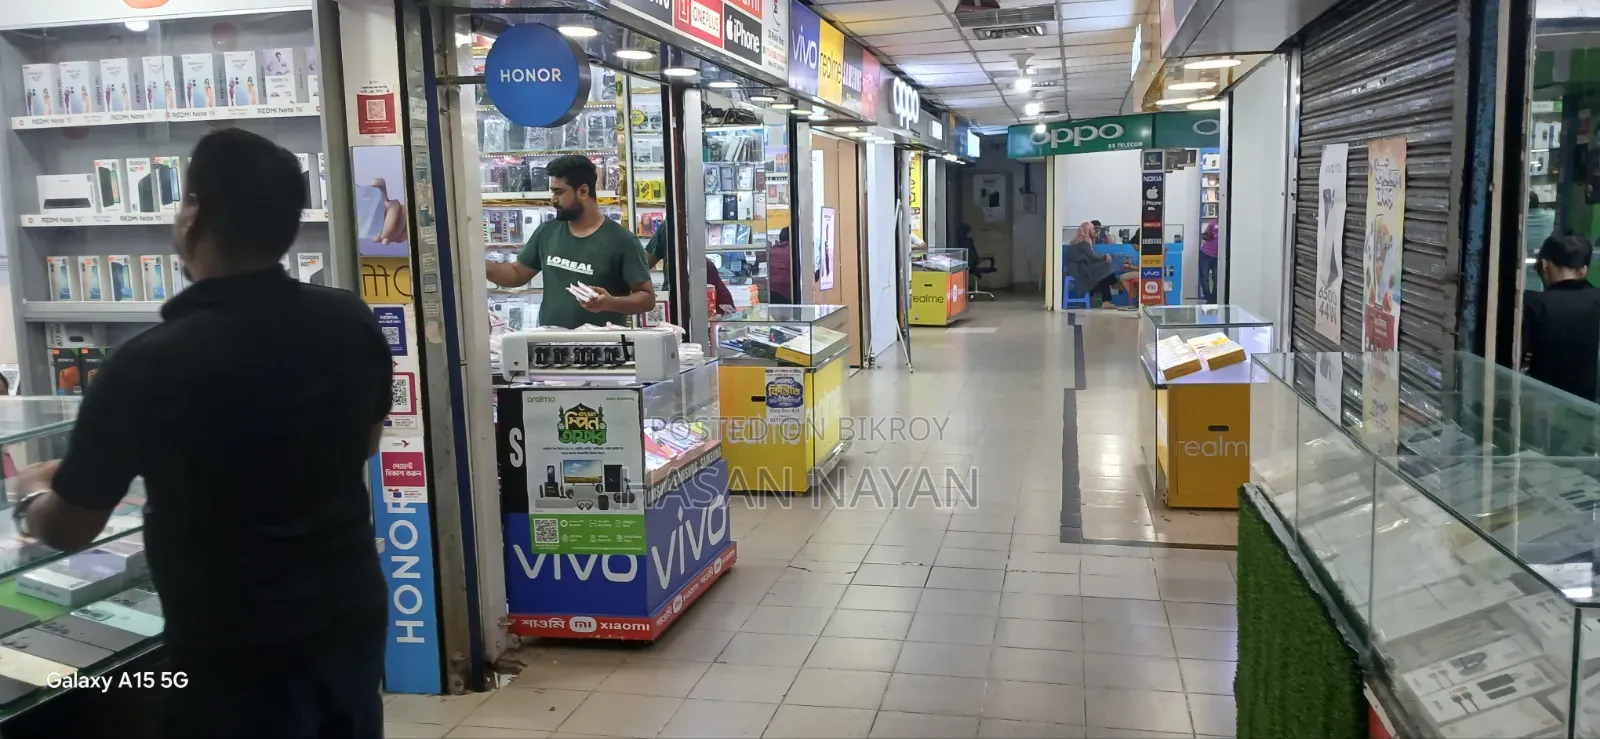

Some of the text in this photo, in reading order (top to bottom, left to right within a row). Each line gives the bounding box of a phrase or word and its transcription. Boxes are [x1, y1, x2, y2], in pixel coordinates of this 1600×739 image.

[733, 18, 760, 53] iPhone
[791, 25, 818, 70] vivo
[500, 68, 562, 82] HONOR
[820, 50, 842, 84] realme
[893, 76, 920, 130] oppo
[1030, 123, 1124, 148] oppo
[546, 255, 594, 271] LOREAL
[1319, 287, 1337, 305] 6500
[1319, 301, 1337, 325] 44W
[1176, 436, 1248, 457] realm
[651, 494, 728, 590] vivo
[513, 544, 638, 583] vivo
[521, 617, 566, 629] শাওমি
[600, 621, 650, 631] xiaomi
